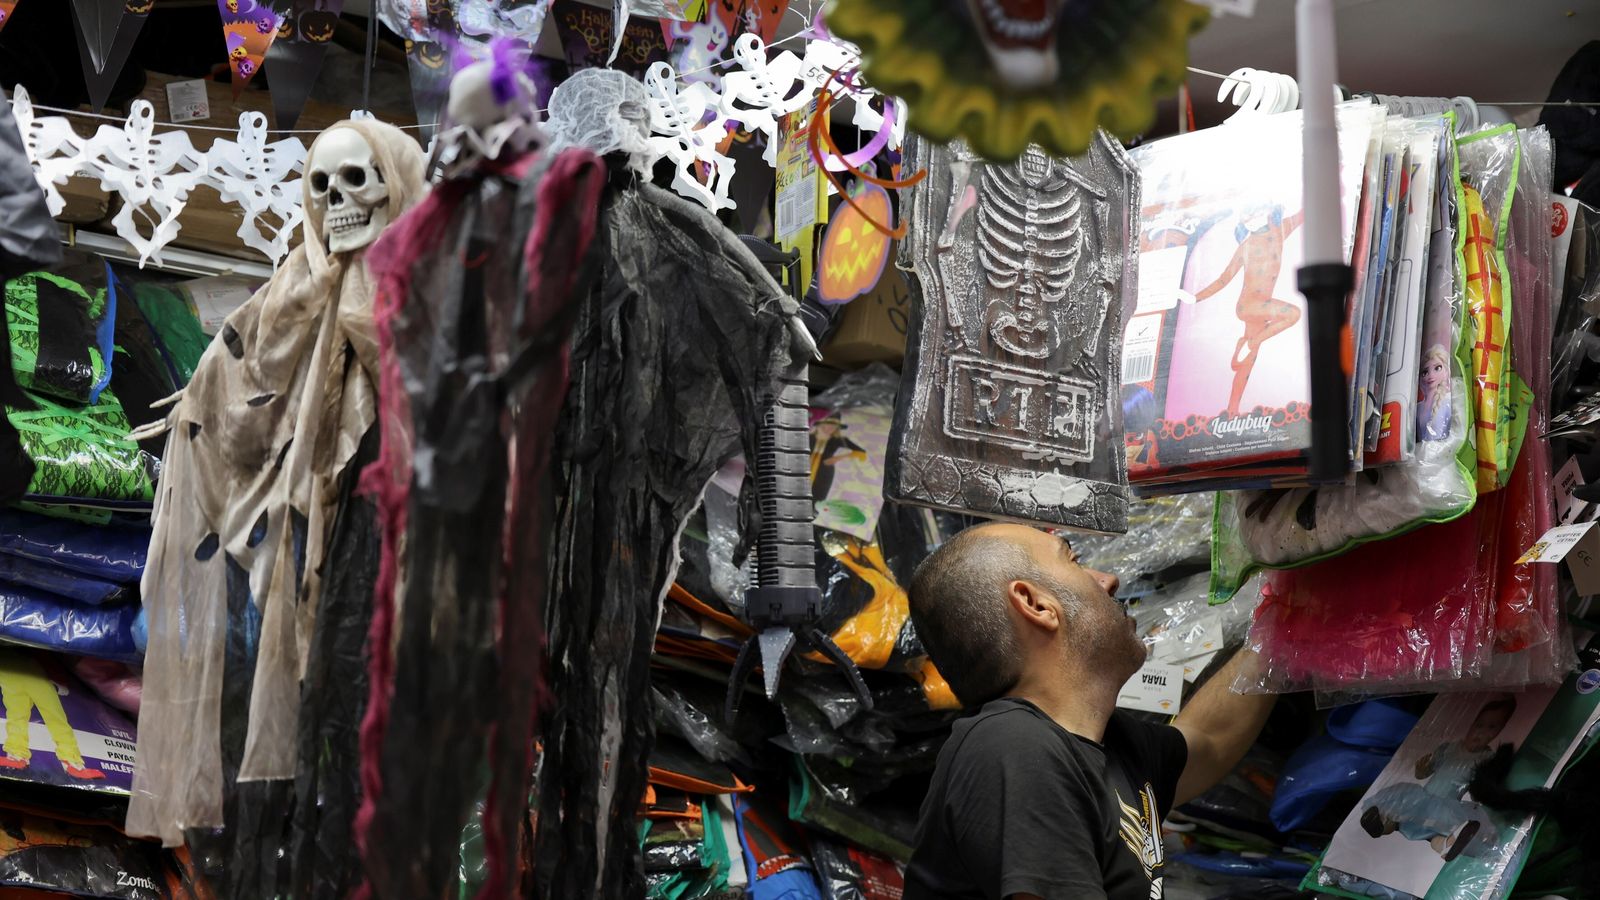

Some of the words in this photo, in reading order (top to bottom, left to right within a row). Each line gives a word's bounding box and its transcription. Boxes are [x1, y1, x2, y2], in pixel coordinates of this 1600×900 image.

[1211, 414, 1273, 436] Ladybug
[1142, 673, 1167, 687] TIARA
[111, 729, 133, 740] EVIL
[104, 738, 136, 752] CLOWN
